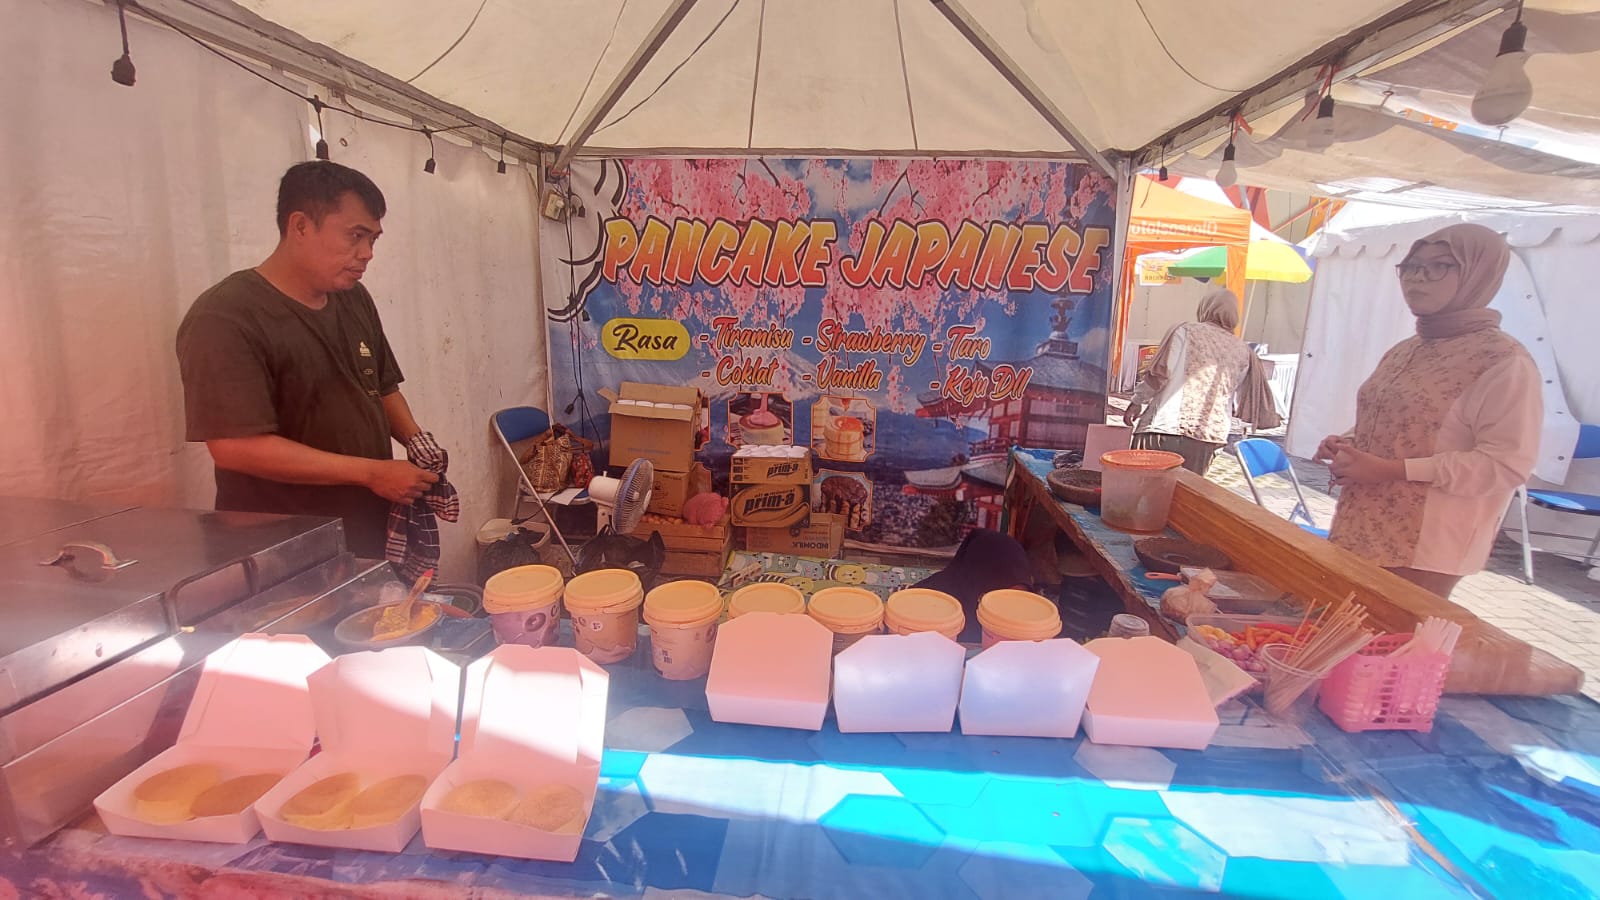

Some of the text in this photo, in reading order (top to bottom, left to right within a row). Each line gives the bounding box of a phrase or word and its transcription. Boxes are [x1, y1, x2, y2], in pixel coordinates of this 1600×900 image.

[603, 216, 1110, 293] PANCAKE JAPANESE
[612, 323, 678, 354] Rasa
[713, 316, 794, 349] Tiramisu
[816, 318, 926, 365] Strawberry
[947, 325, 991, 360] Taro
[716, 355, 780, 386] Coklat
[816, 357, 882, 389] Vanilla
[943, 365, 989, 407] Keju
[766, 462, 799, 478] prim-a
[743, 492, 796, 516] prim-a
